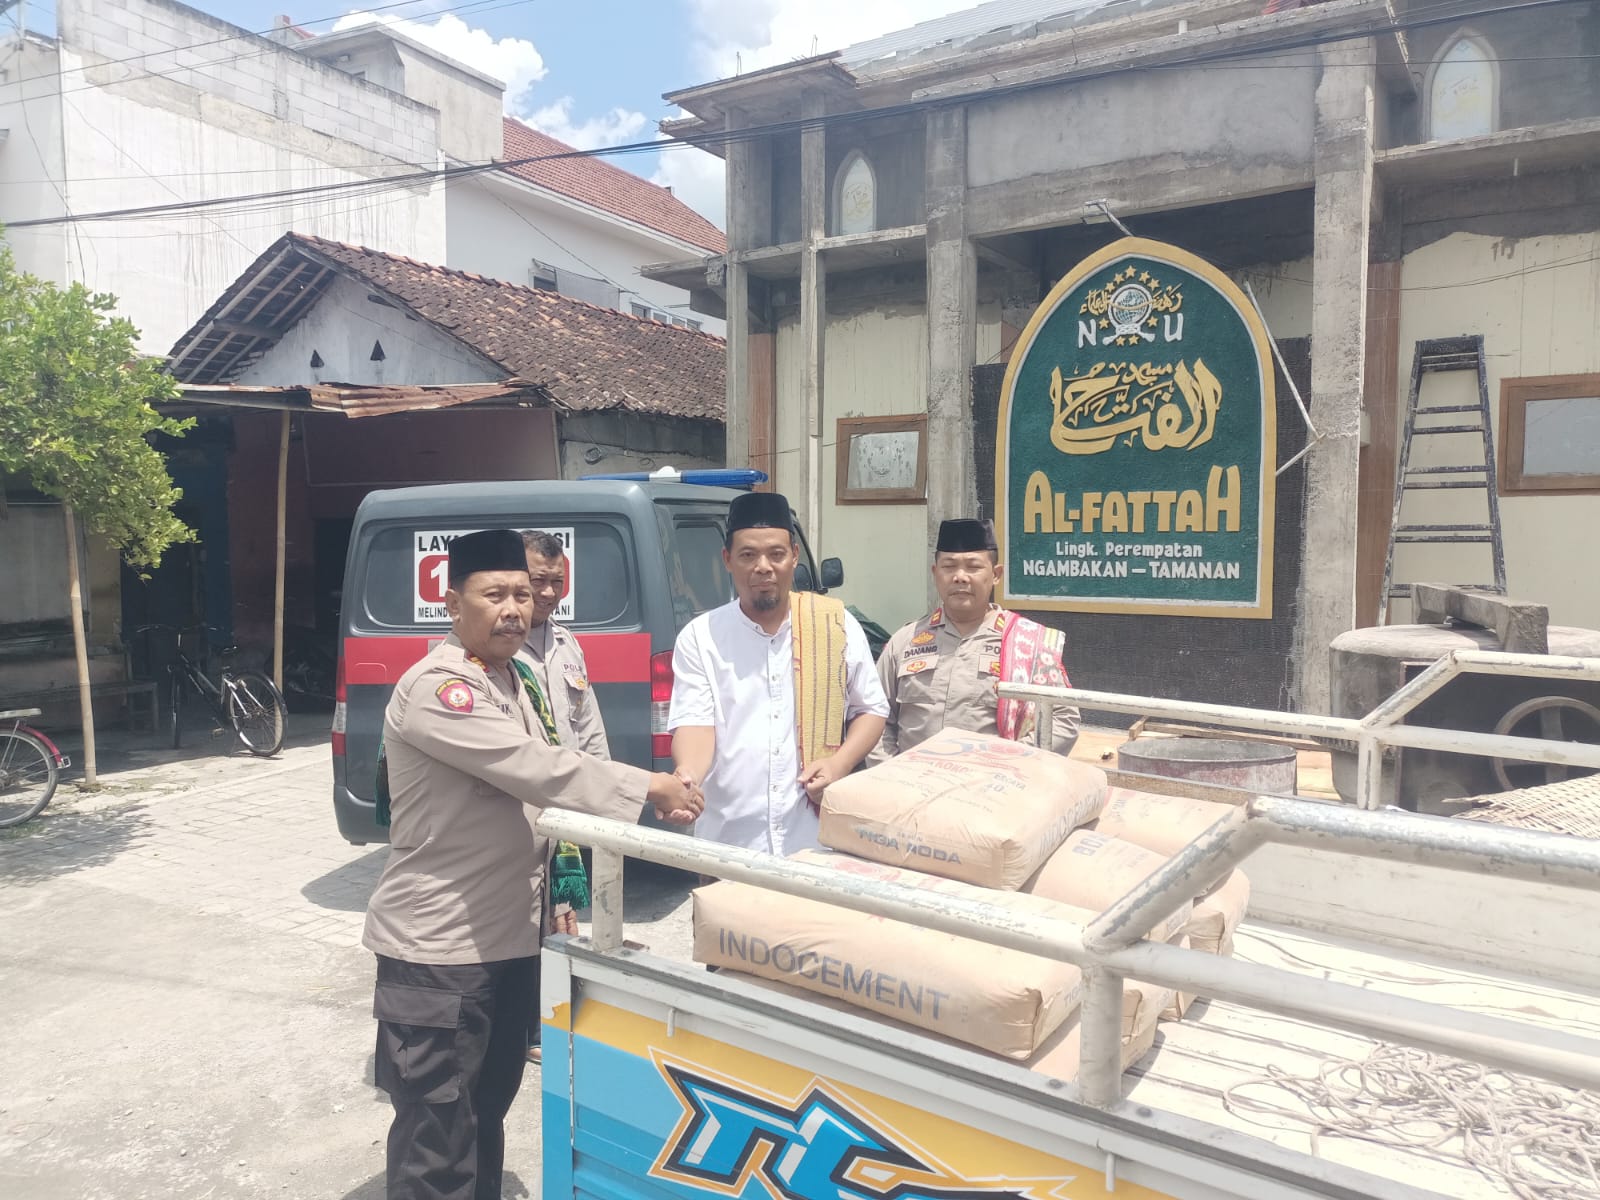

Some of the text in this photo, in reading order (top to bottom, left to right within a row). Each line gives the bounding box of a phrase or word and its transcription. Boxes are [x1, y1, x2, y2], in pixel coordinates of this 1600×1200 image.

[1077, 313, 1183, 348] N U
[1023, 464, 1241, 533] AL-FATTAH
[1055, 541, 1203, 558] Lingk. Perempatan
[1023, 560, 1128, 578] NGAMBAKAN
[1149, 561, 1240, 579] TAMANAN
[904, 645, 938, 659] DANANG
[718, 928, 949, 1021] INDOCEMENT
